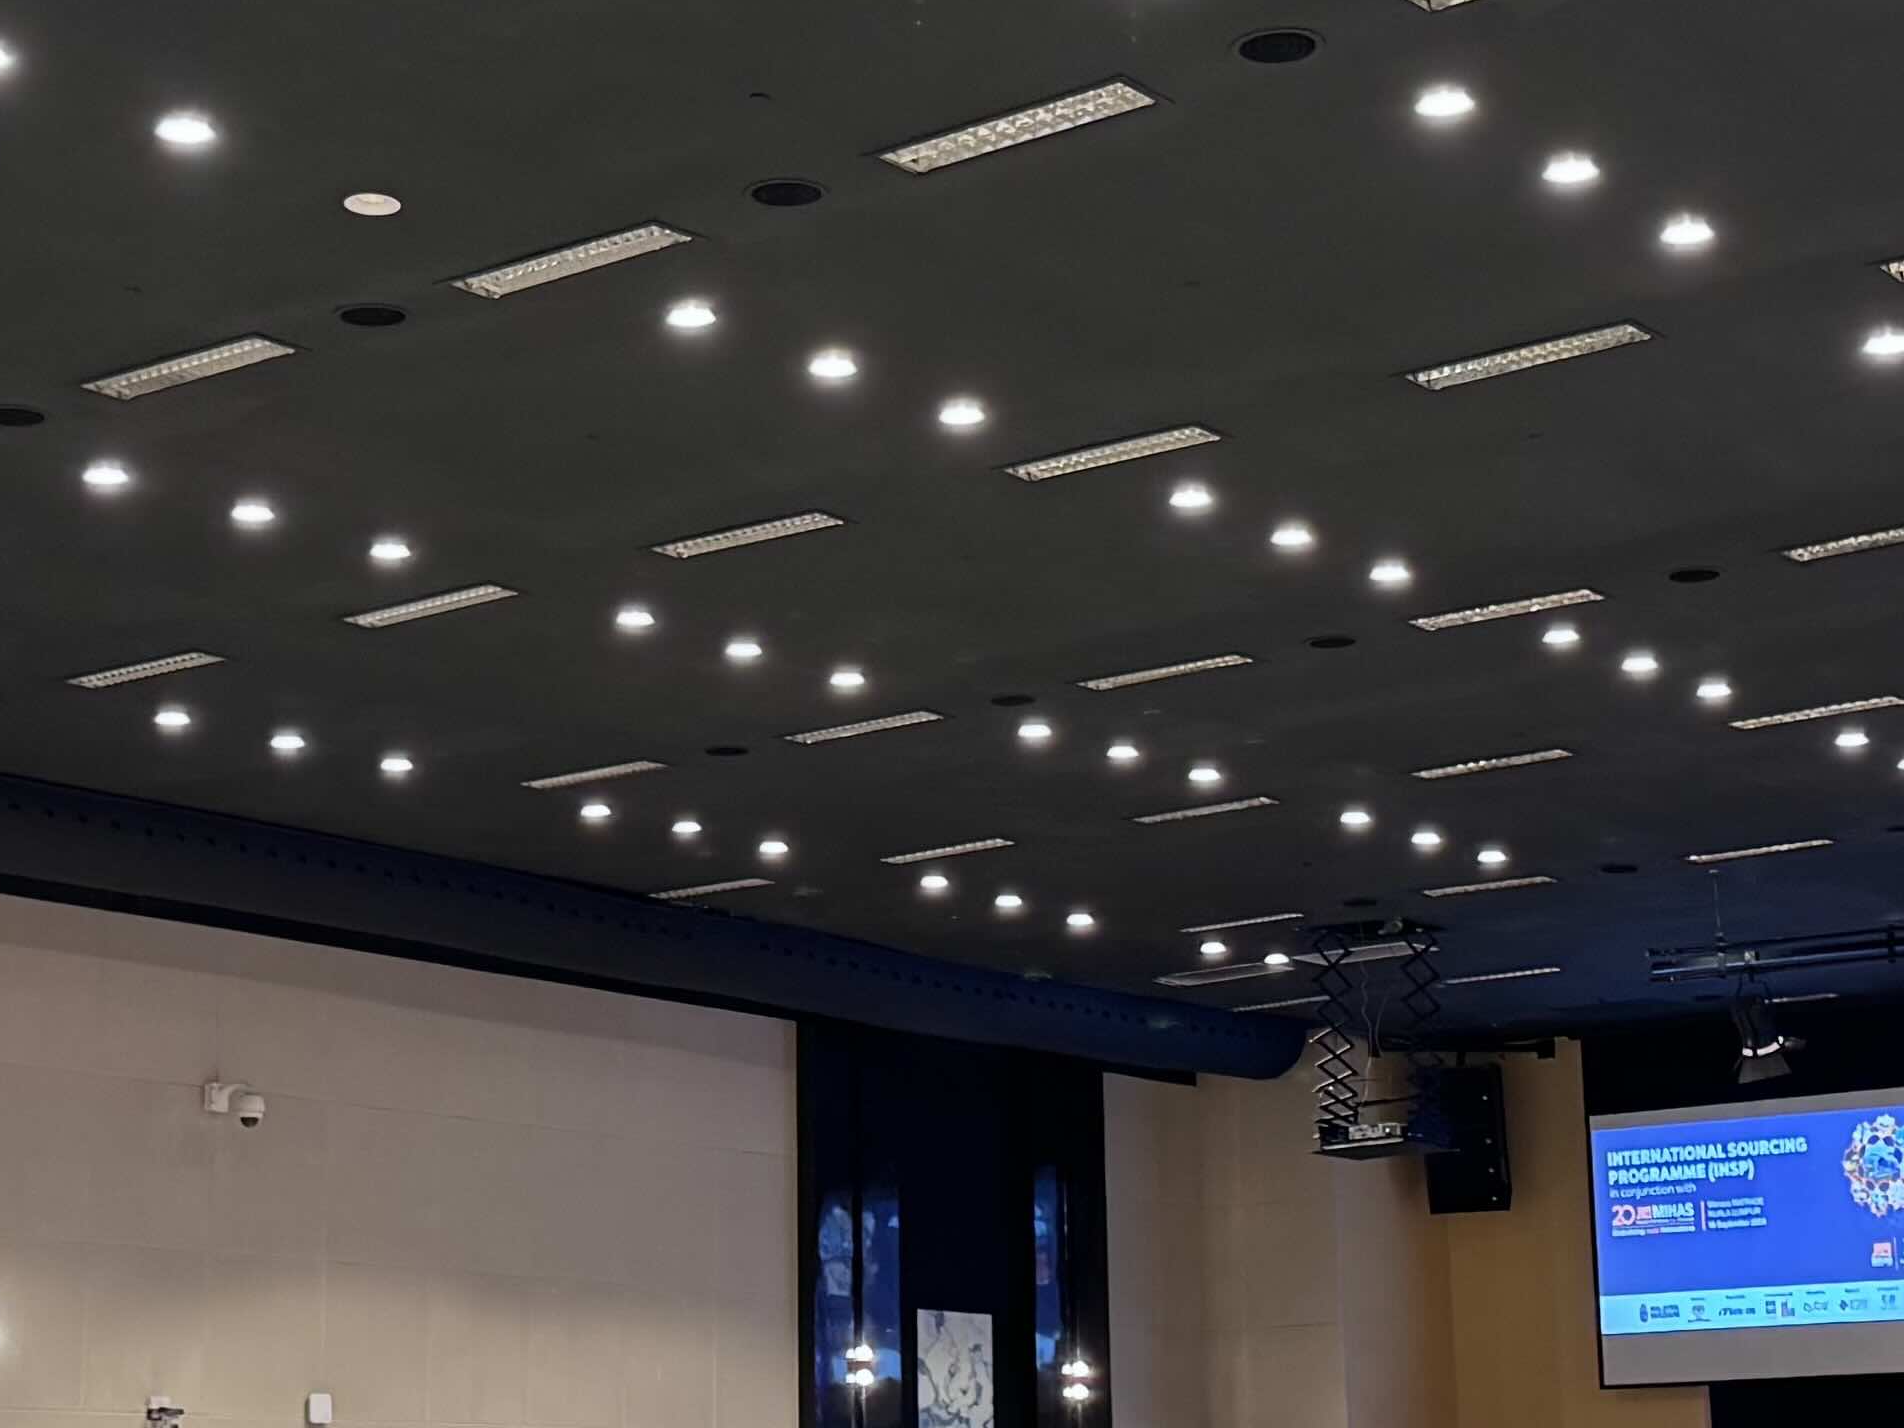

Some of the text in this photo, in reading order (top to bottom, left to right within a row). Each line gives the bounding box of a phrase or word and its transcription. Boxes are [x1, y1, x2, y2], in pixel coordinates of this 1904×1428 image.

[1607, 1137, 1808, 1167] INTERNATIONAL SOURCING
[1608, 1163, 1706, 1185] PROGRAMME
